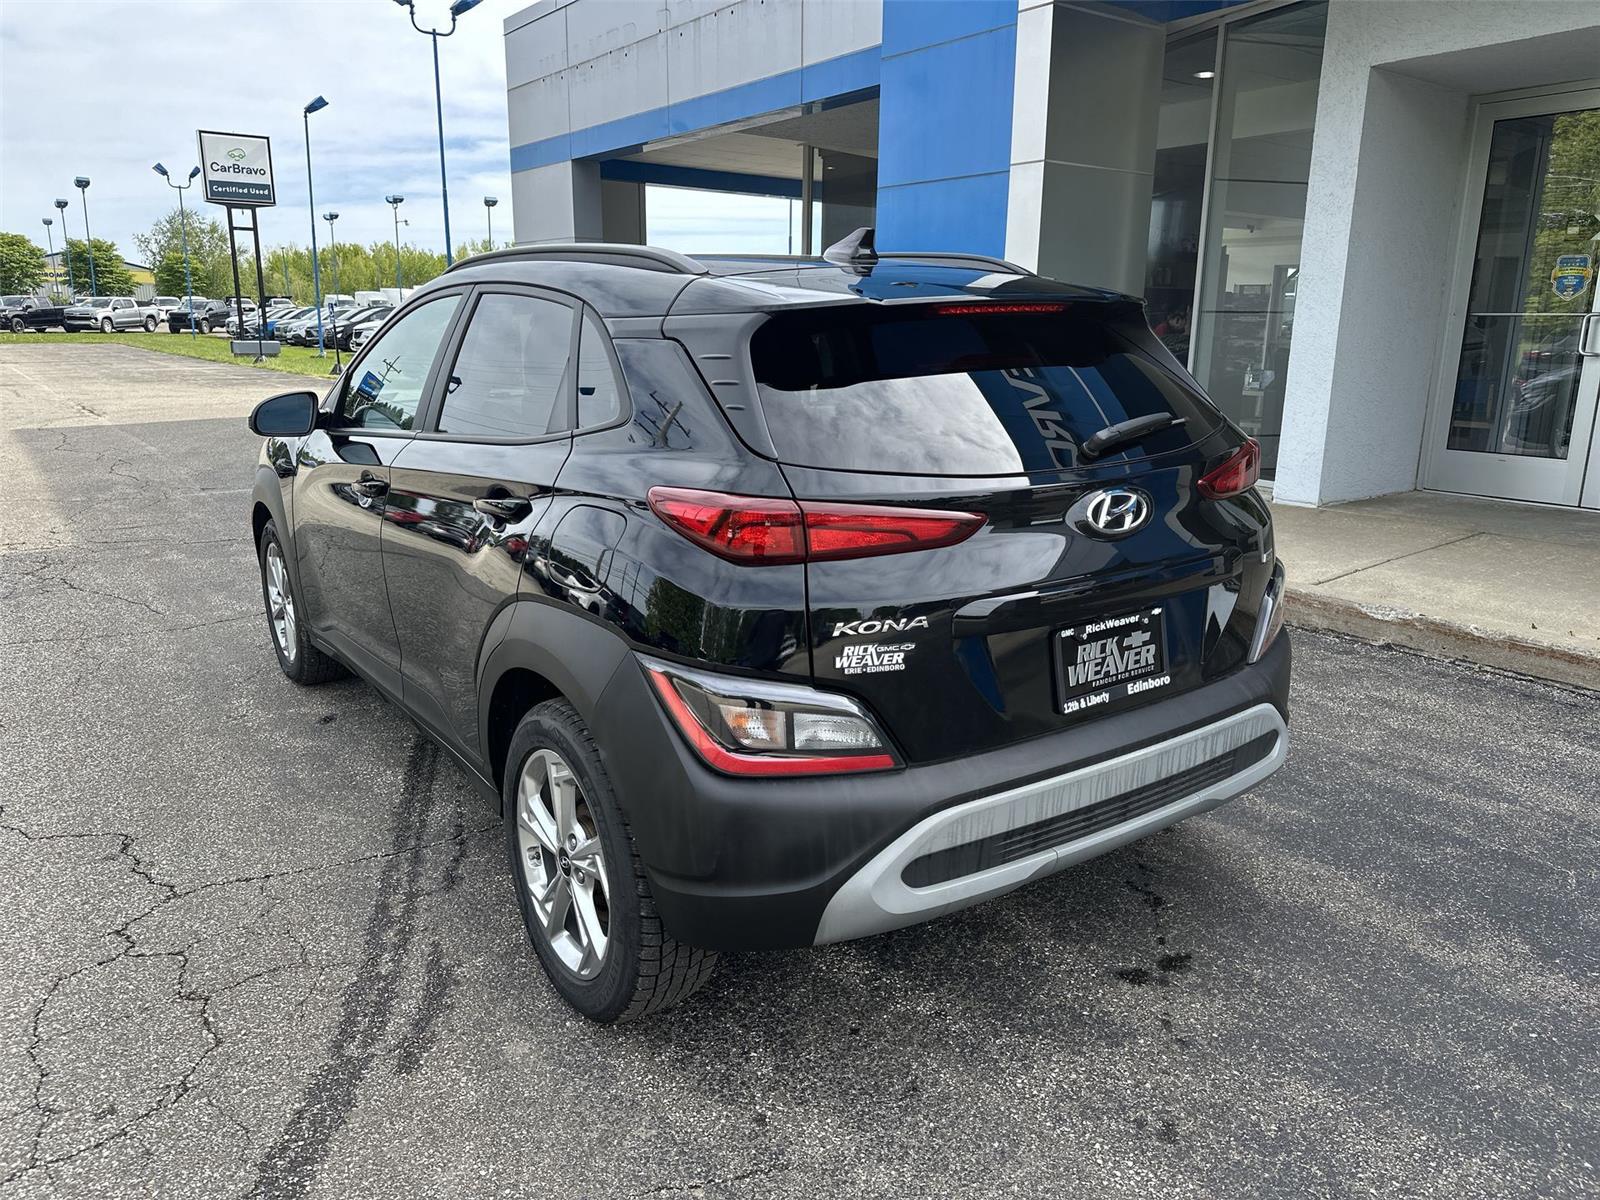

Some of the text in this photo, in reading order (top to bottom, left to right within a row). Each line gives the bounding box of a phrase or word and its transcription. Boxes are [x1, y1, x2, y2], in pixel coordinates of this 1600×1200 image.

[210, 161, 266, 176] CarBravo
[212, 185, 269, 195] Certified Used
[832, 616, 929, 637] KONA
[1061, 628, 1075, 638] GMC
[842, 643, 900, 657] RICK GMC
[1077, 636, 1119, 664] RICK
[835, 651, 905, 669] WEAVER
[1068, 644, 1156, 687] WEAVER
[1127, 675, 1171, 695] Edinboro
[1063, 692, 1110, 714] 12th & Liberty
